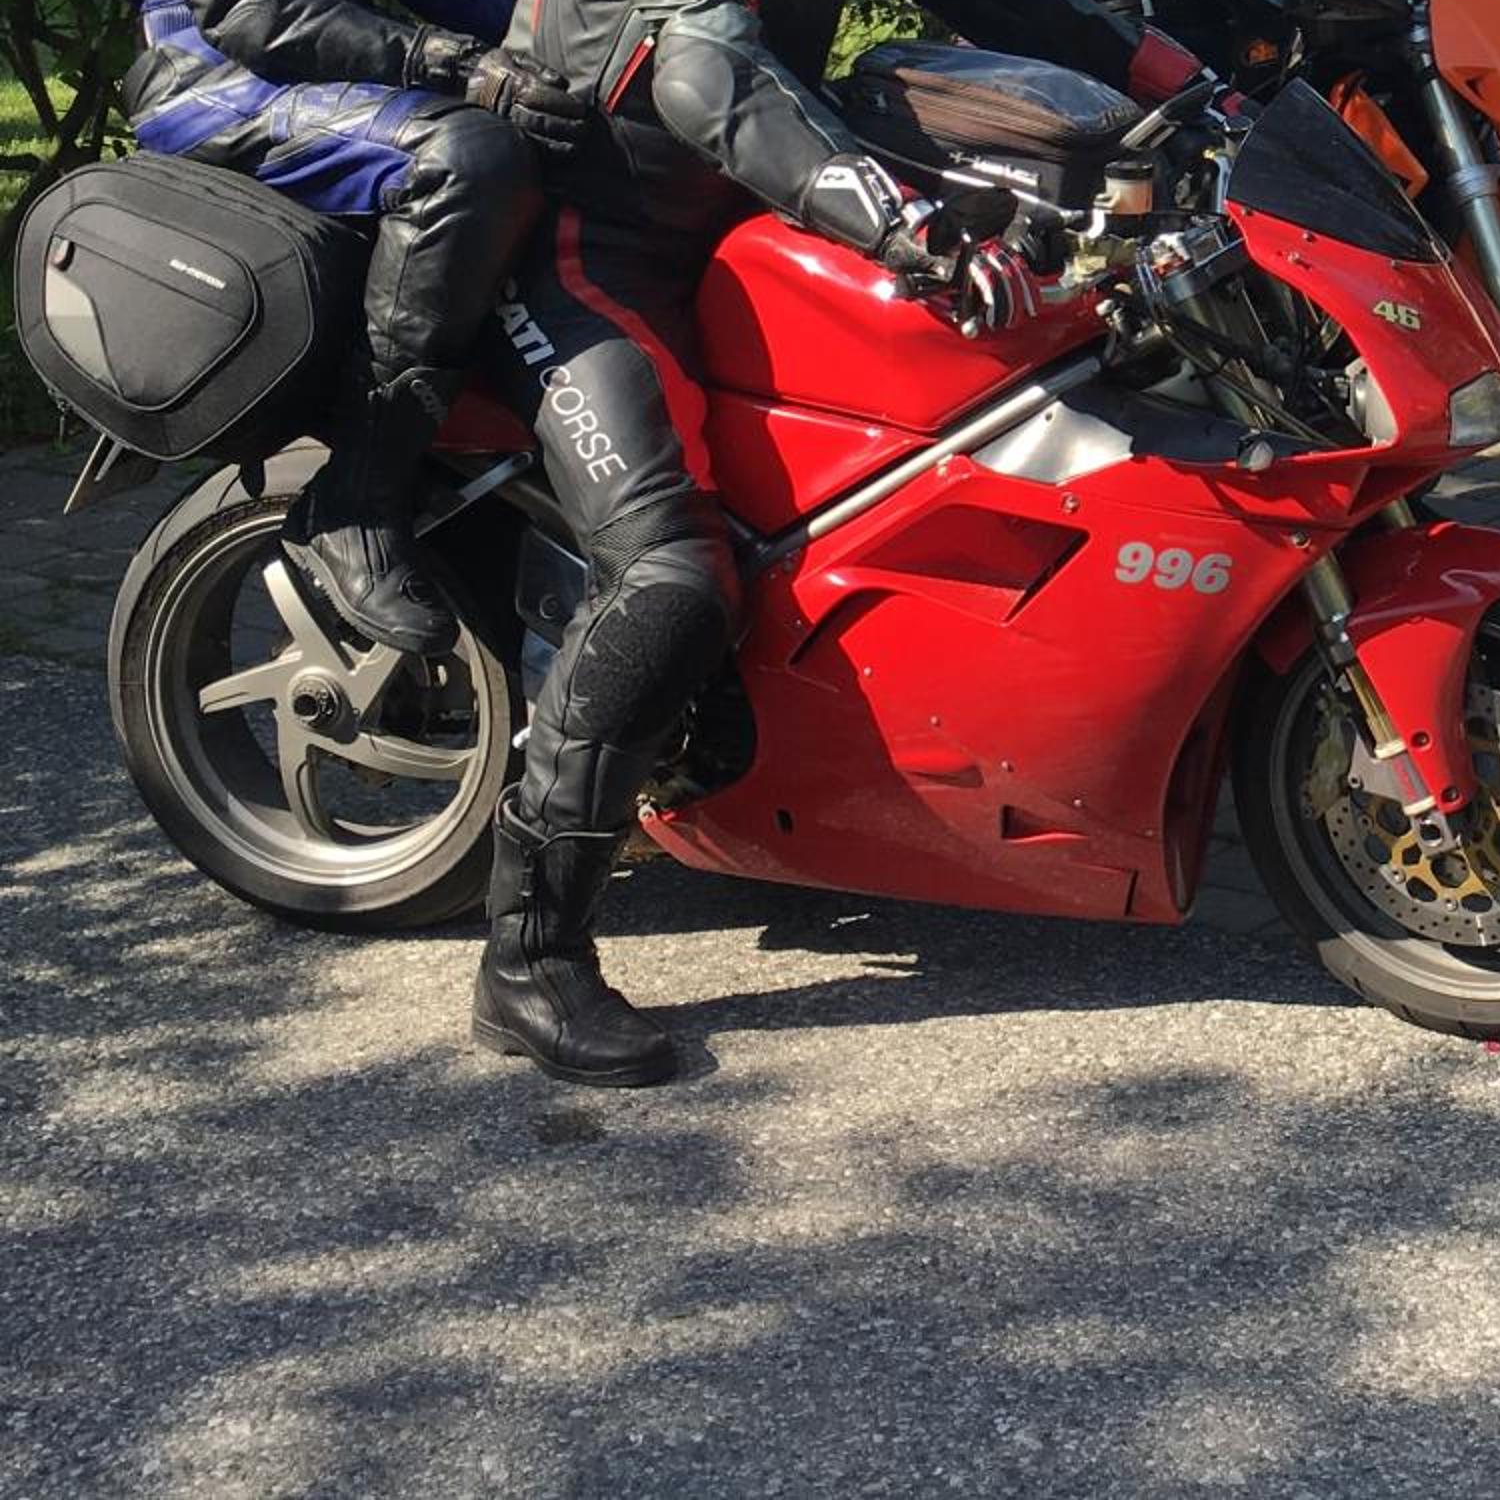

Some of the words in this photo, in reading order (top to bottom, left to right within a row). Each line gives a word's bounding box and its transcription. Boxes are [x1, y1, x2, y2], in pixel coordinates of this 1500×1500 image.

[1372, 300, 1421, 331] 46
[539, 365, 628, 484] CORSE
[1114, 541, 1233, 594] 996
